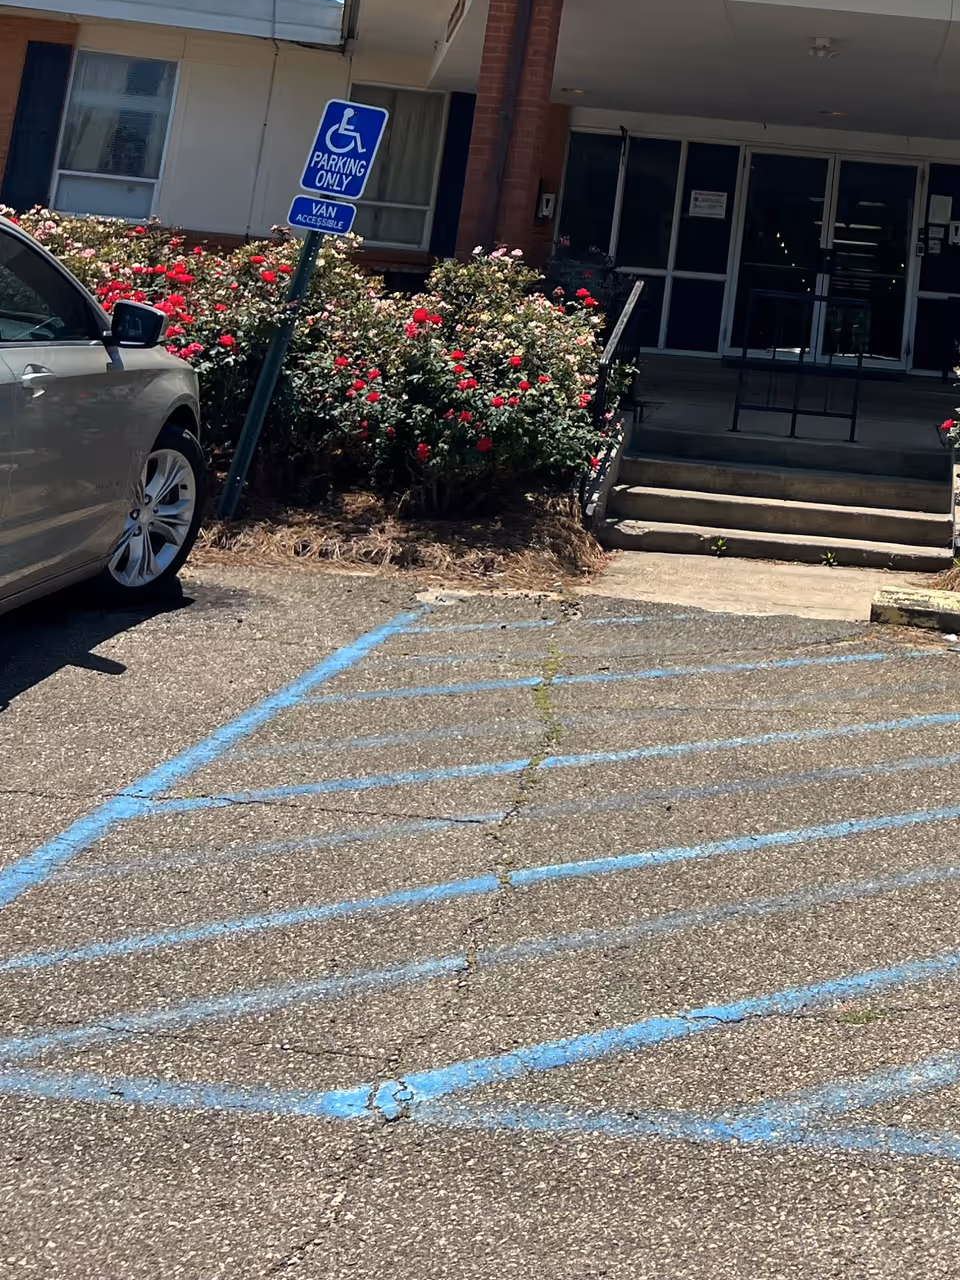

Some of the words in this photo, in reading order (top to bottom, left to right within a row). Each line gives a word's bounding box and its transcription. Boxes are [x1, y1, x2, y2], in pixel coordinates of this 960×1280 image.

[311, 152, 366, 177] PARKING
[315, 171, 352, 191] ONLY
[312, 202, 337, 218] VAN
[296, 214, 344, 229] ACCESSIBLE
